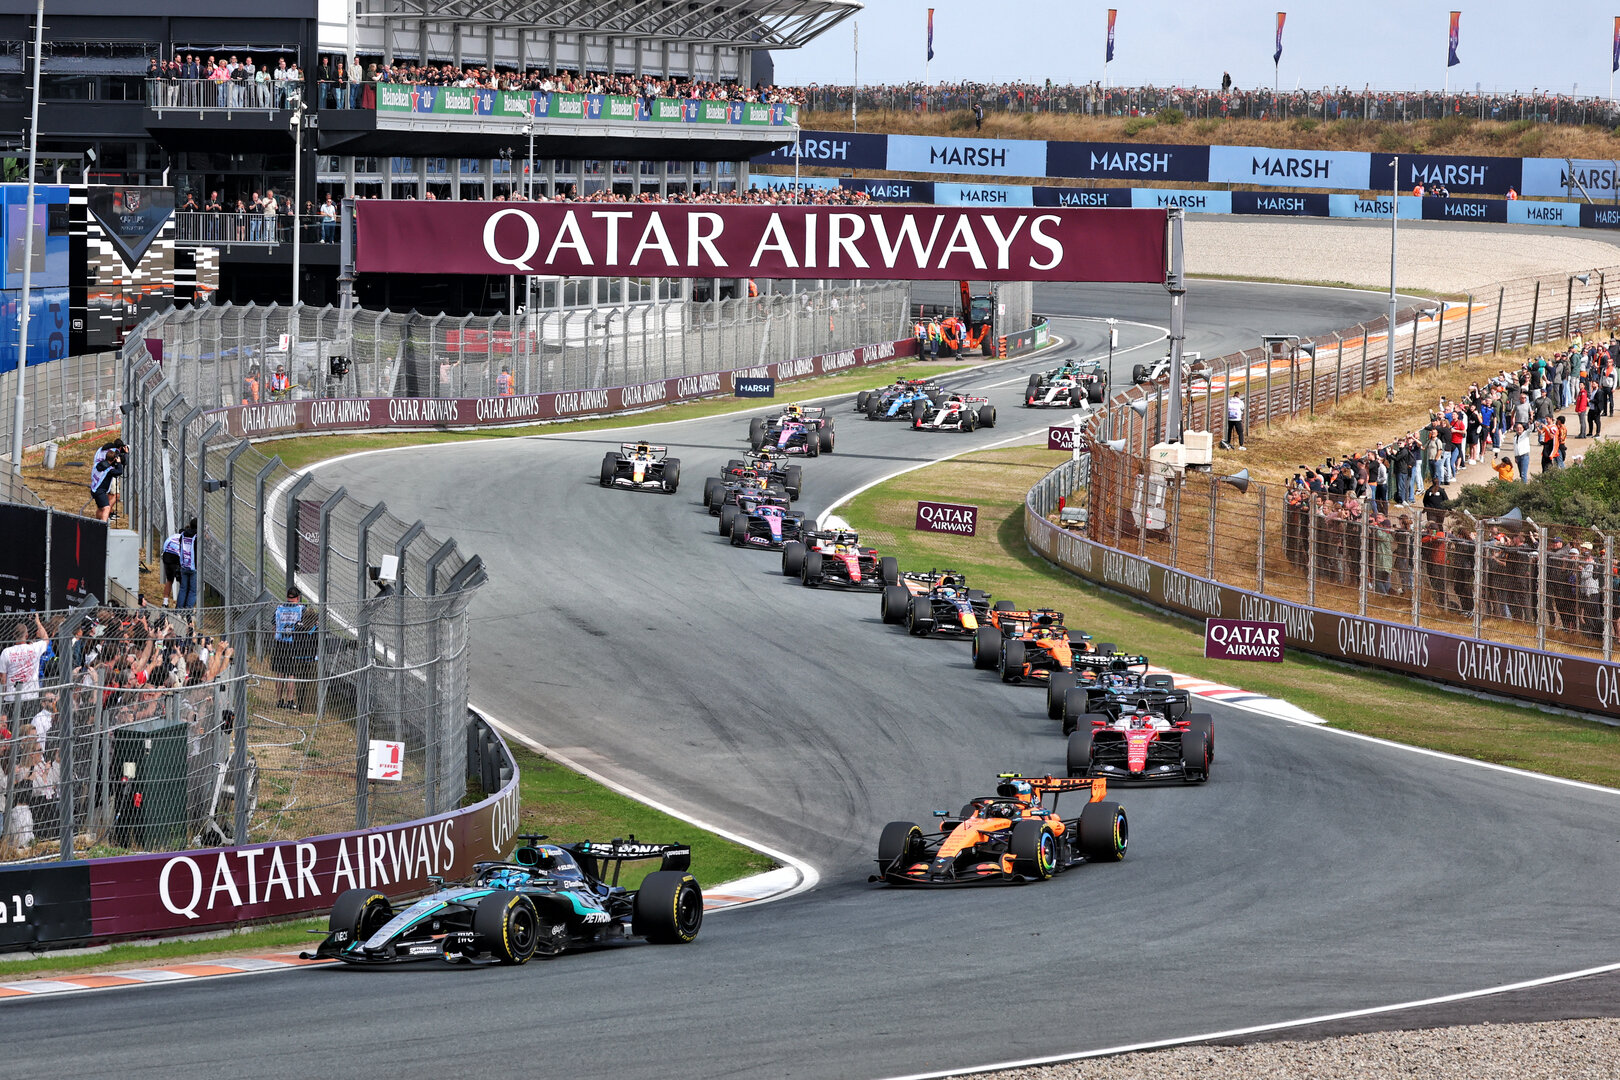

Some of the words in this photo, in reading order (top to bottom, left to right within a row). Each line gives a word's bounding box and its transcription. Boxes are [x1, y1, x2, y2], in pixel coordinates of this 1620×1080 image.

[382, 88, 409, 107] Heineken
[445, 91, 471, 110] Heineken
[504, 95, 528, 112] Heineken
[559, 97, 582, 114] Heineken
[611, 99, 633, 116] Heineken
[660, 102, 680, 118] Heineken
[706, 104, 726, 120] Heineken
[750, 106, 768, 121] Heineken
[930, 146, 1005, 167] MARSH
[1090, 151, 1169, 172] MARSH
[1252, 156, 1329, 178] MARSH
[1411, 163, 1485, 185] MARSH
[865, 184, 911, 198] MARSH
[960, 189, 1007, 202] MARSH
[1059, 192, 1107, 206] MARSH
[1157, 195, 1206, 208] MARSH
[1257, 197, 1304, 211] MARSH
[1444, 203, 1486, 217] MARSH
[1527, 207, 1563, 220] MARSH
[483, 209, 728, 271] QATAR
[750, 212, 1064, 271] AIRWAYS
[621, 386, 642, 407] QATAR
[642, 381, 667, 403] AIRWAYS
[677, 375, 698, 397] QATAR
[698, 373, 721, 394] AIRWAYS
[740, 384, 770, 392] MARSH
[388, 399, 420, 423] QATAR
[420, 400, 458, 421] AIRWAYS
[476, 398, 505, 420] QATAR
[505, 395, 539, 418] AIRWAYS
[555, 392, 579, 415] QATAR
[579, 389, 609, 412] AIRWAYS
[242, 406, 266, 434] QATAR
[266, 402, 297, 428] AIRWAYS
[311, 401, 336, 426] QATAR
[336, 400, 371, 422] AIRWAYS
[920, 506, 973, 524] QATAR
[931, 521, 973, 533] AIRWAYS
[1103, 550, 1123, 584] QATAR
[1124, 556, 1150, 593] AIRWAYS
[1163, 570, 1187, 606] QATAR
[1188, 578, 1222, 617] AIRWAYS
[1240, 594, 1270, 621] QATAR
[1273, 603, 1315, 643] AIRWAYS
[1210, 625, 1280, 646] QATAR
[1338, 617, 1376, 657] QATAR
[1379, 625, 1429, 668] AIRWAYS
[1225, 644, 1280, 658] AIRWAYS
[1457, 641, 1501, 683] QATAR
[1504, 651, 1564, 695] AIRWAYS
[159, 843, 322, 919] QATAR
[332, 819, 455, 894] AIRWAYS
